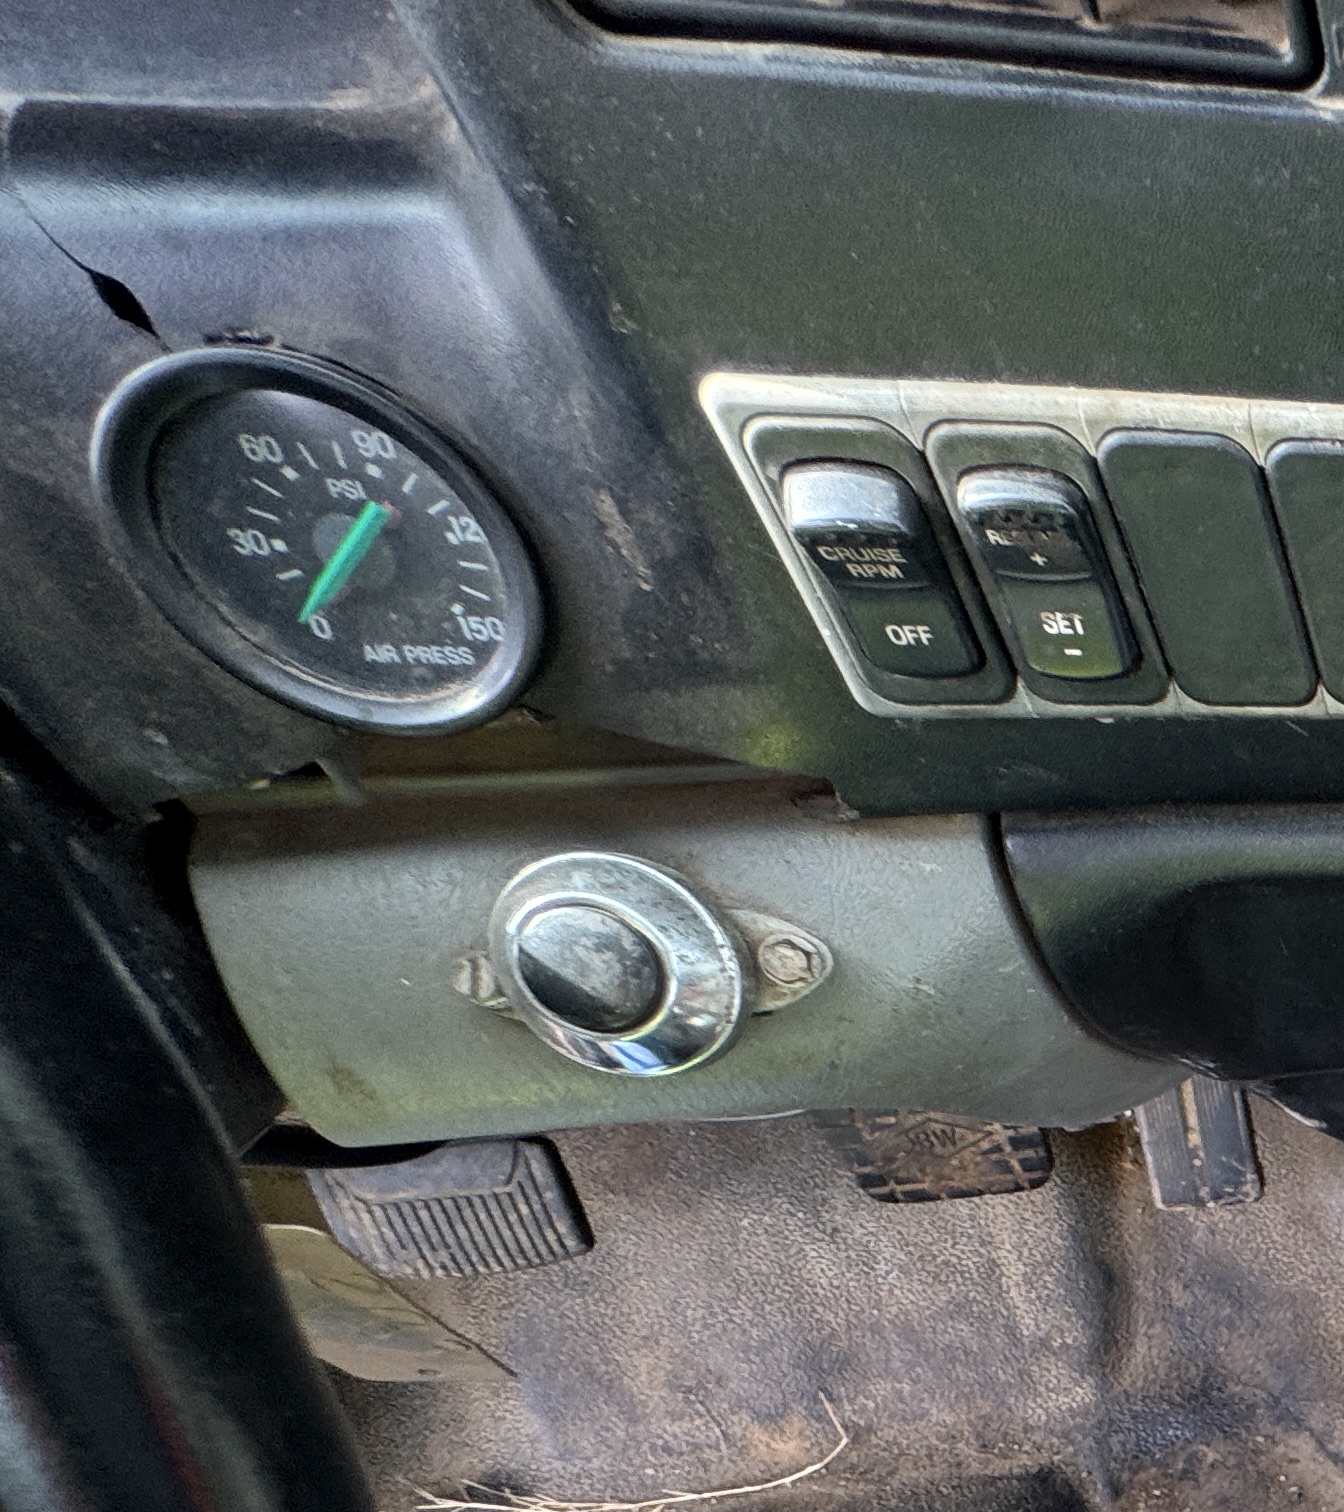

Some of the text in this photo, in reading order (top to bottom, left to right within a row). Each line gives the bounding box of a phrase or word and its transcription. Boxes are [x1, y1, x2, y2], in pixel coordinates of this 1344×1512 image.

[238, 433, 284, 463] 60
[351, 430, 397, 459] 90
[325, 477, 367, 500] PSI
[226, 528, 271, 556] 30
[449, 516, 490, 543] 12
[816, 545, 908, 564] CRUISE
[846, 563, 905, 579] RPM
[309, 615, 334, 641] 0
[457, 615, 505, 642] 150
[884, 624, 934, 646] OFF
[1040, 610, 1086, 636] SET
[362, 643, 476, 666] AIR PRESS
